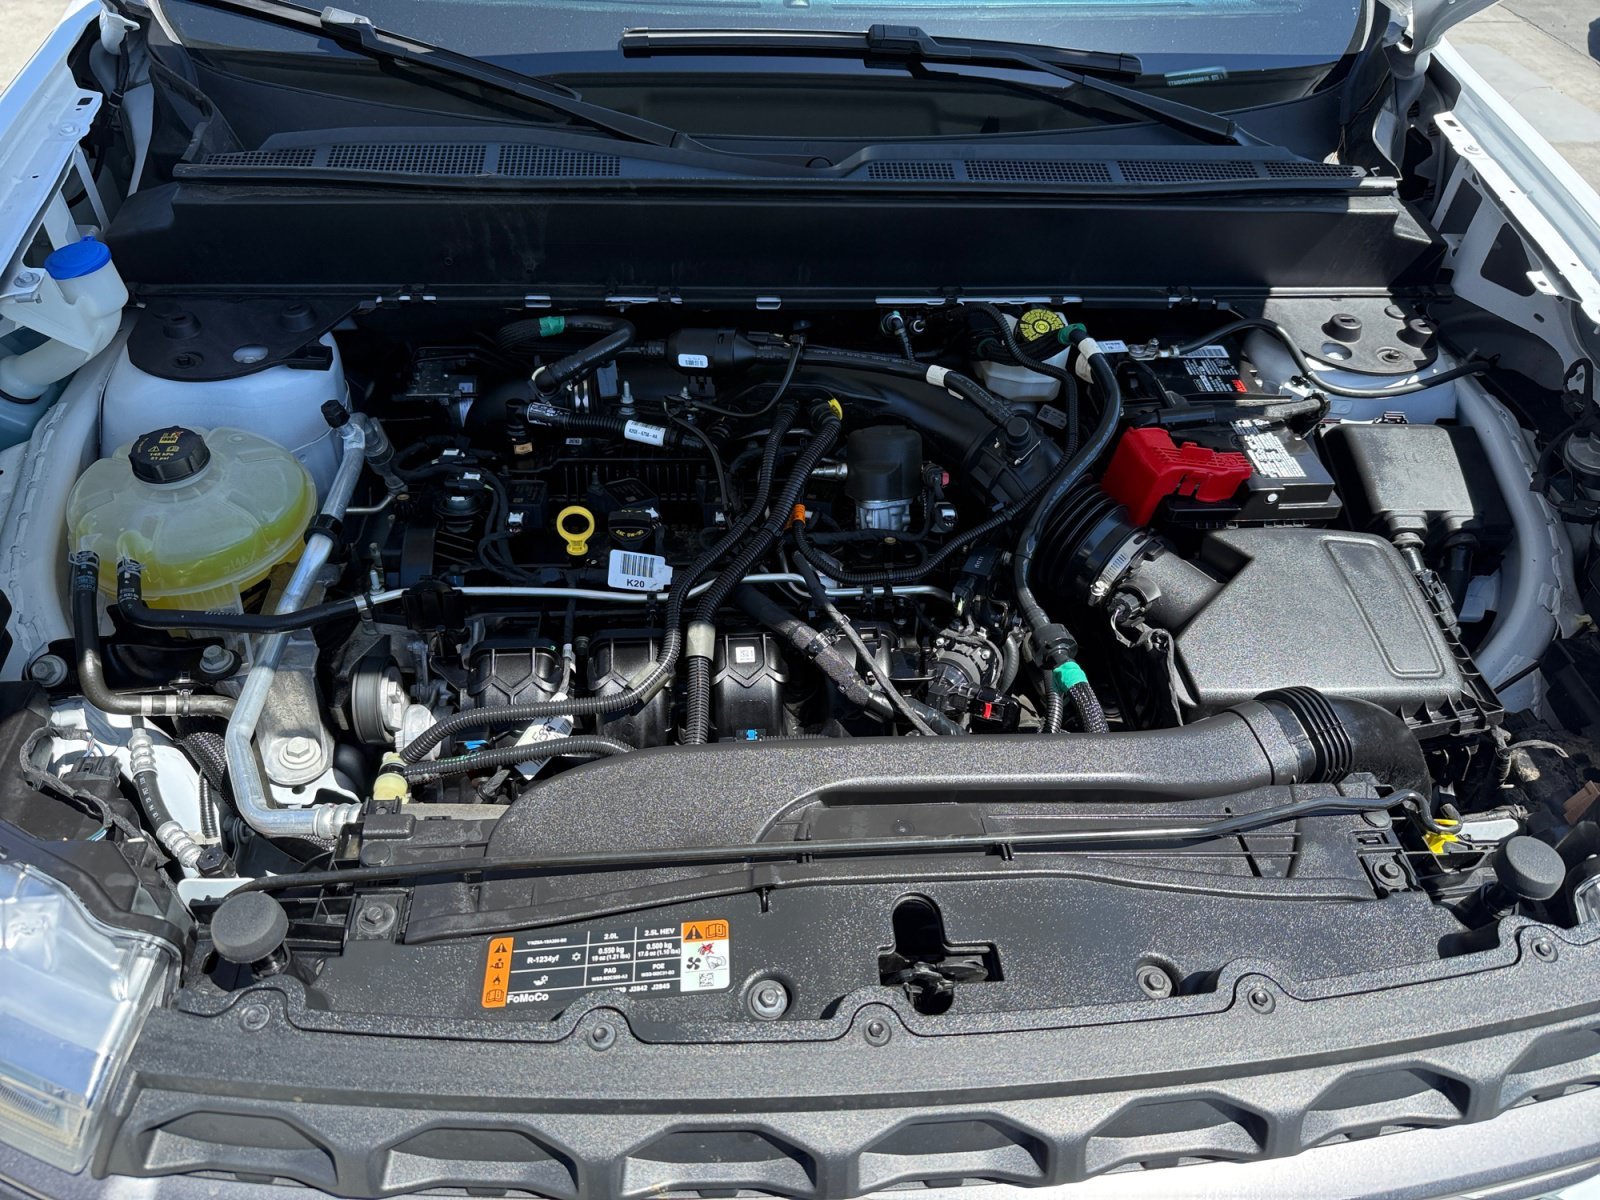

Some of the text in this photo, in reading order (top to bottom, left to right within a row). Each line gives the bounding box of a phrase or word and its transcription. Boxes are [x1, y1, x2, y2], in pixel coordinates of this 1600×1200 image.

[626, 579, 645, 588] K20
[603, 932, 619, 940] 2.0L
[616, 946, 625, 954] kg
[664, 941, 673, 950] kg
[526, 954, 560, 965] R-1234yf
[603, 967, 617, 975] PAG
[506, 992, 549, 1004] FoMoCo
